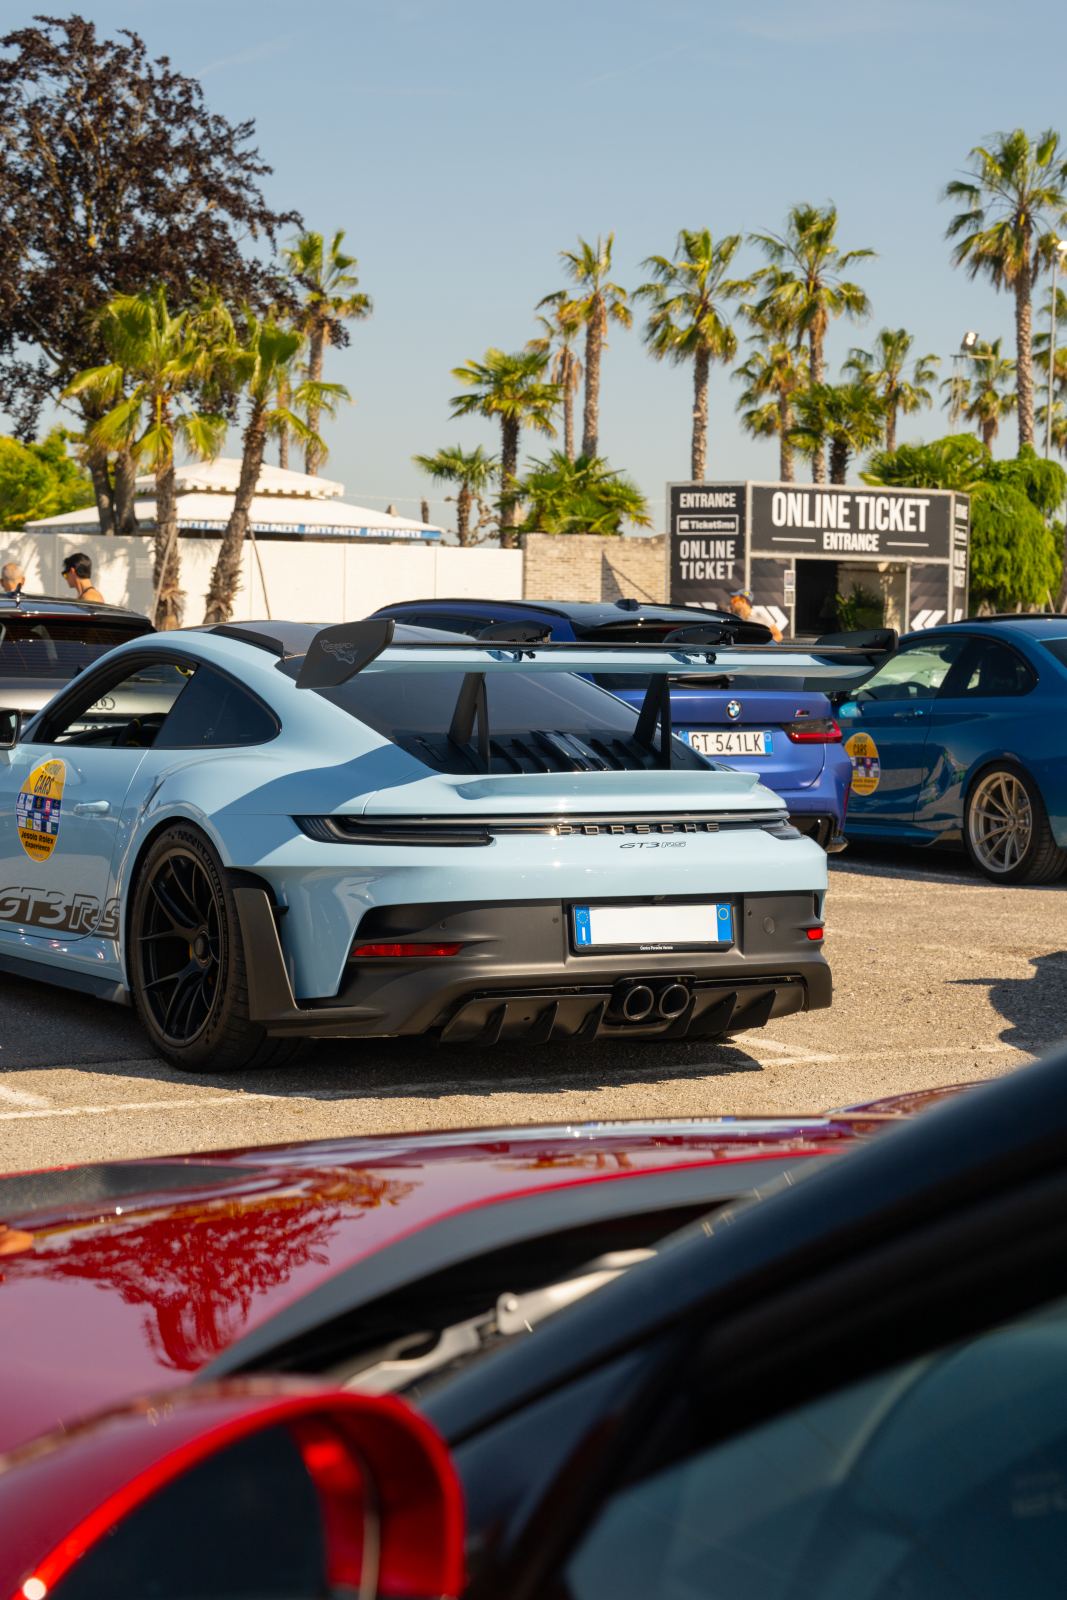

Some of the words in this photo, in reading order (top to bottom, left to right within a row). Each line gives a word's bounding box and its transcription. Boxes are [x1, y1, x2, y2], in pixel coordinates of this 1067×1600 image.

[680, 493, 737, 508] ENTRANCE
[771, 491, 850, 530] ONLINE
[855, 495, 930, 533] TICKET
[680, 540, 736, 559] ONLINE
[823, 532, 880, 552] ENTRANCE
[680, 561, 735, 580] TICKET
[691, 734, 709, 752] GT
[716, 734, 762, 752] 541LK
[556, 823, 720, 836] PORSCHE
